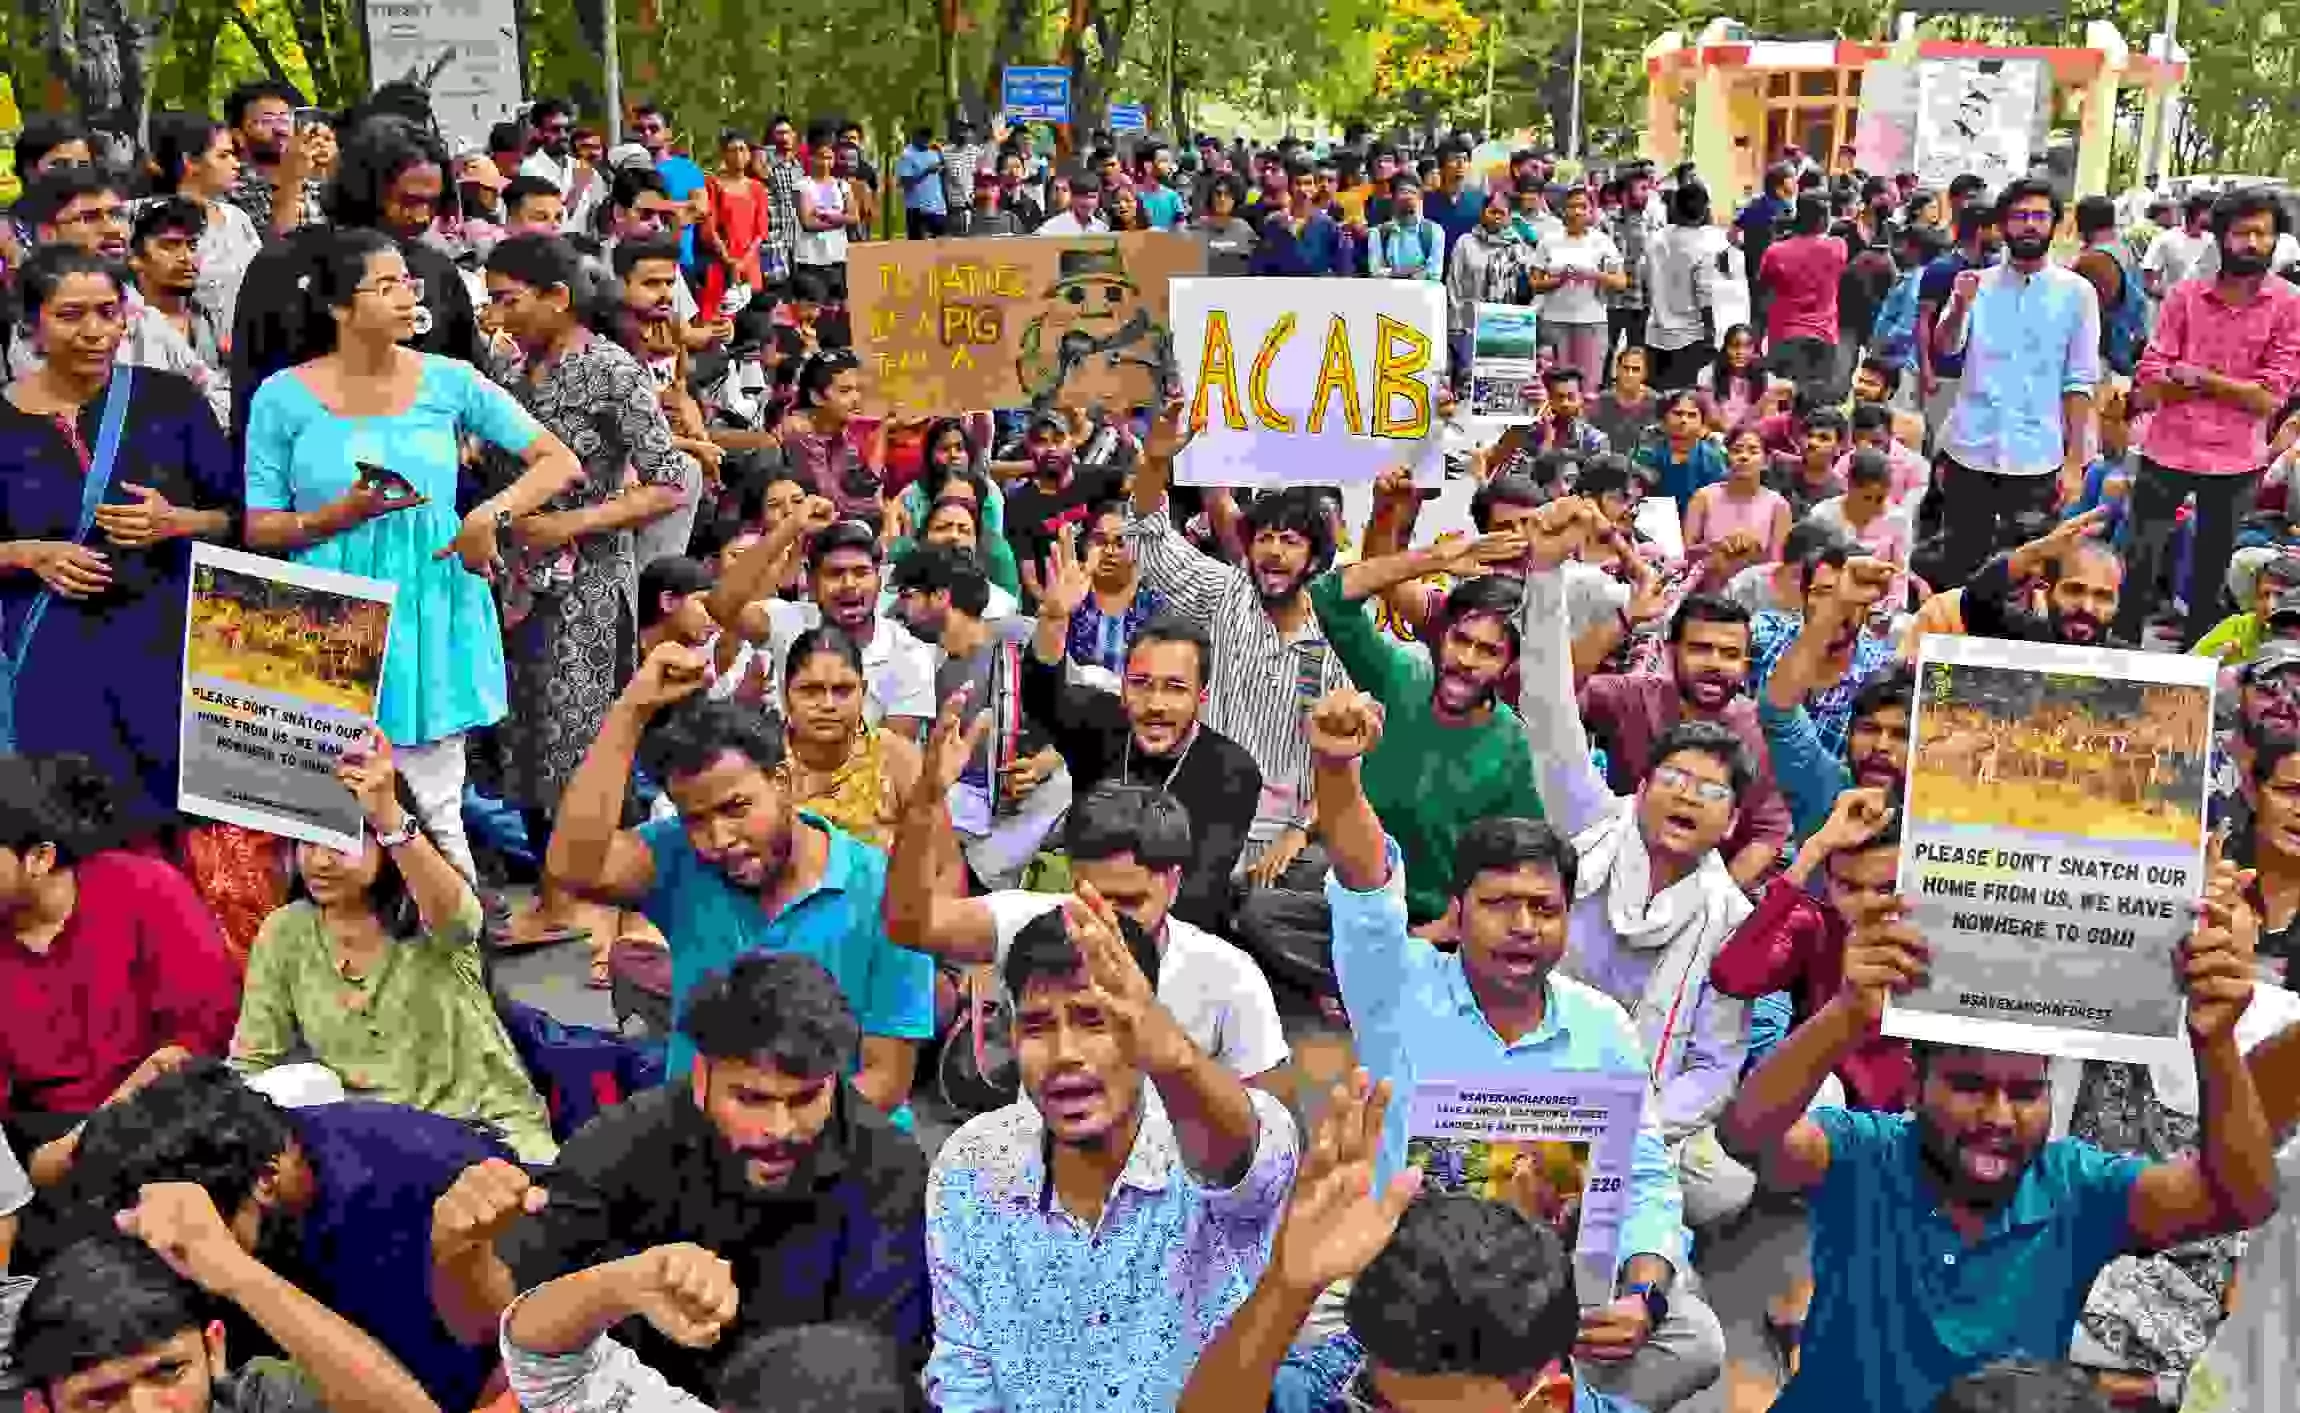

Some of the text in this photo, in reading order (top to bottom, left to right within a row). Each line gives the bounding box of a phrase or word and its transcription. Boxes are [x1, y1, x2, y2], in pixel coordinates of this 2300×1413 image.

[943, 306, 999, 344] PIG
[951, 343, 977, 370] A
[1188, 309, 1433, 440] ACAB
[191, 687, 363, 742] PLEASE DON'T SNATCH OUR
[197, 711, 232, 729] HOME
[235, 719, 268, 738] FROM
[295, 736, 313, 750] WE
[317, 742, 344, 756] HAV
[280, 753, 297, 767] TO
[1914, 843, 2187, 888] PLEASE DON'T SNATCH OUR
[1921, 876, 2175, 919] HOME FROM US, WE HAVE
[1952, 912, 2049, 939] NOWHERE
[2056, 922, 2081, 943] TO
[1959, 991, 2113, 1018] #SAVEKANCHAFOREST
[1459, 1091, 1577, 1106] #SAVEKANCHAFOREST
